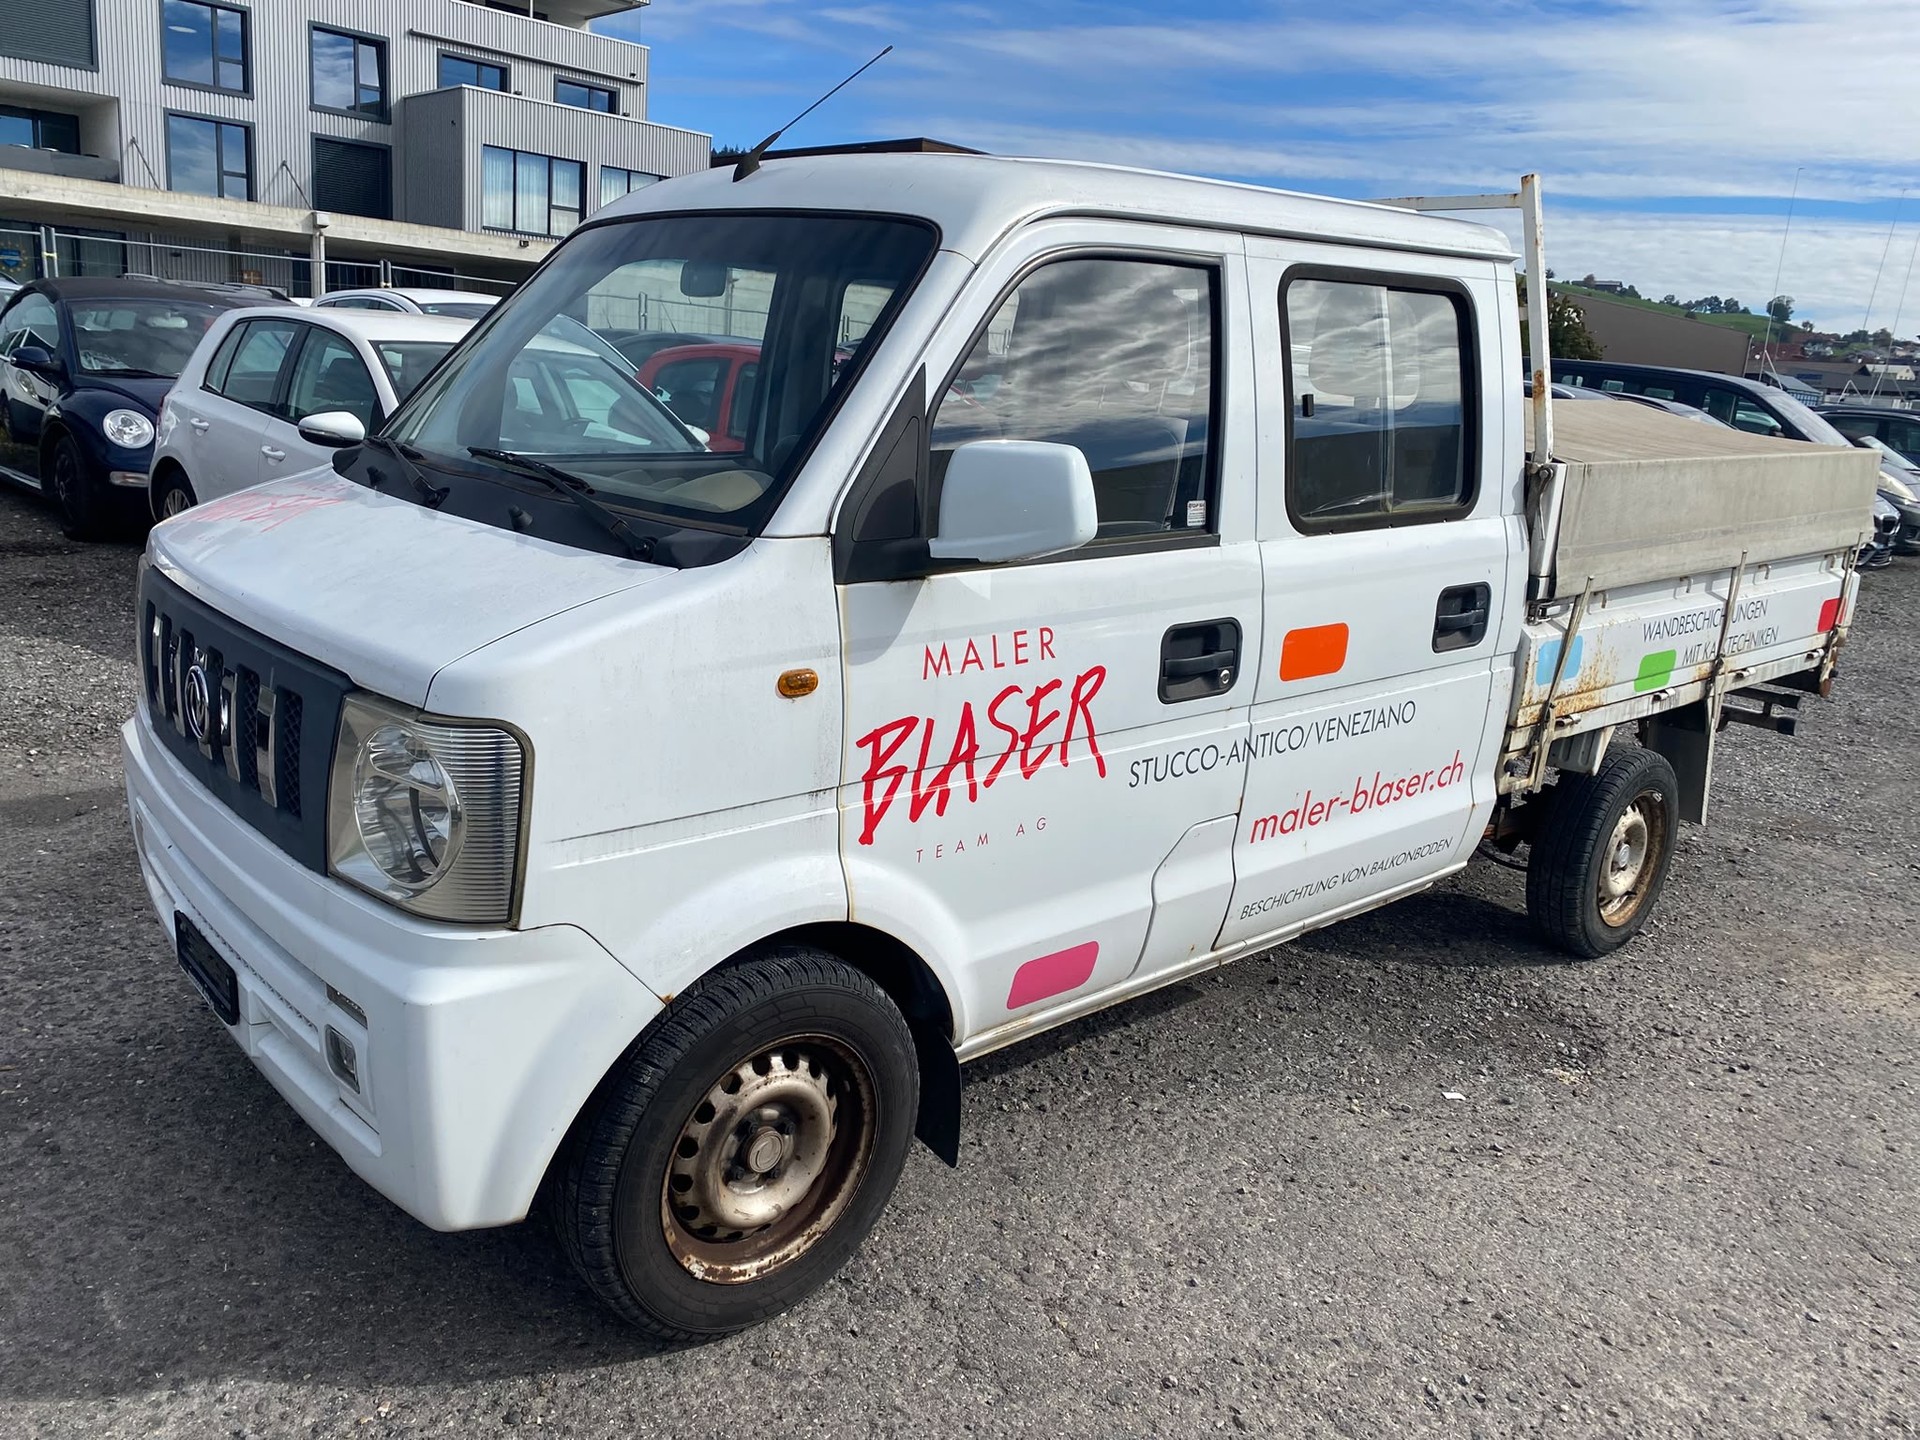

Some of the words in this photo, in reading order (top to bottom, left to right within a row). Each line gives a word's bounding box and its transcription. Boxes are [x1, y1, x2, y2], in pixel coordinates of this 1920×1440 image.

[1643, 600, 1768, 643] WANDBESCHICHUNGEN
[923, 627, 1056, 680] MALER
[1681, 644, 1702, 666] MIT
[856, 665, 1106, 845] BLASER
[1128, 700, 1416, 788] STUCCO-ANTICO/VENEZIANO
[1250, 750, 1464, 844] maler-blaser.ch
[916, 832, 989, 863] TEAM
[1015, 817, 1046, 836] AG
[1239, 874, 1339, 920] BESCHICHTUNG
[1341, 863, 1370, 886] VON
